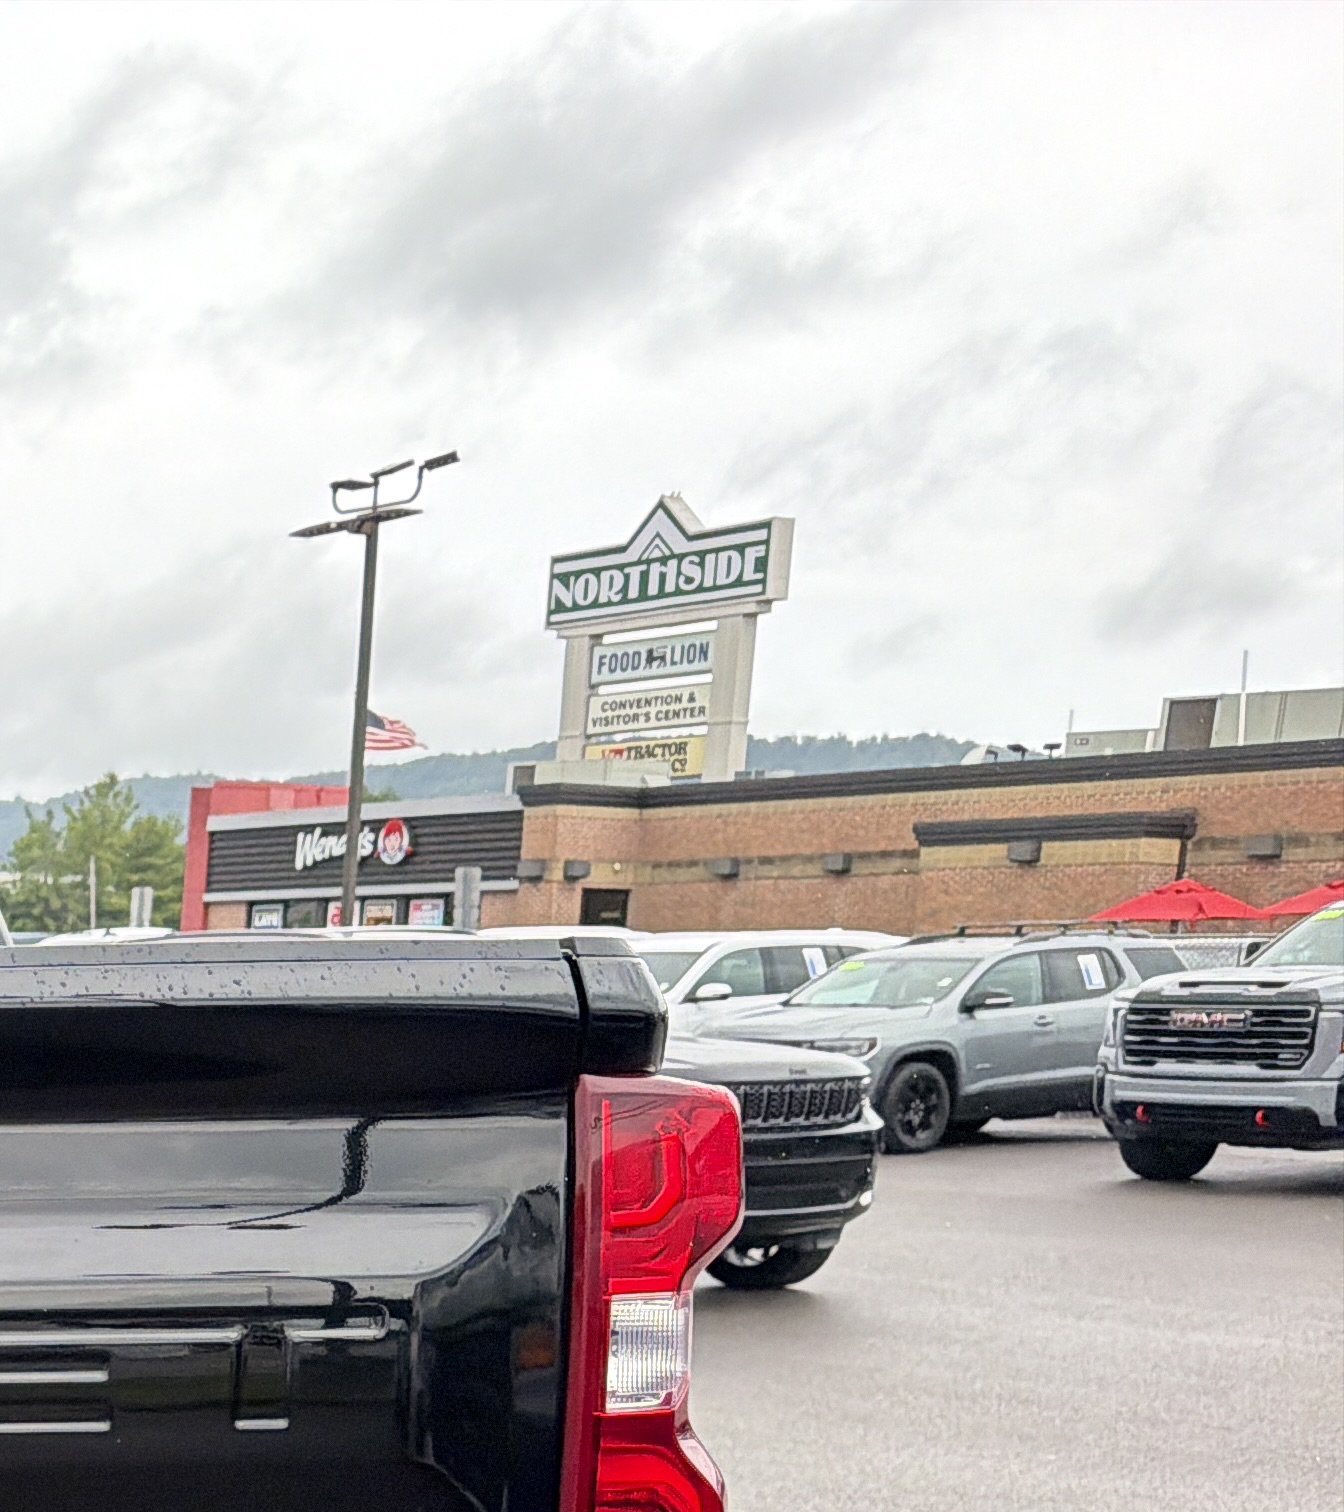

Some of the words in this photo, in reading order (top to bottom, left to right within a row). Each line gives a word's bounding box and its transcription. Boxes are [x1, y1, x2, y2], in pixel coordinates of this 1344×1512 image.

[550, 544, 766, 610] NORTHSIDE
[596, 650, 642, 676] FOOD
[670, 640, 710, 666] LION
[600, 692, 684, 713] CONVENTION
[687, 691, 697, 704] &
[591, 710, 651, 728] VISITOR'S
[655, 705, 706, 722] CENTER
[625, 742, 688, 760] TRACTOR
